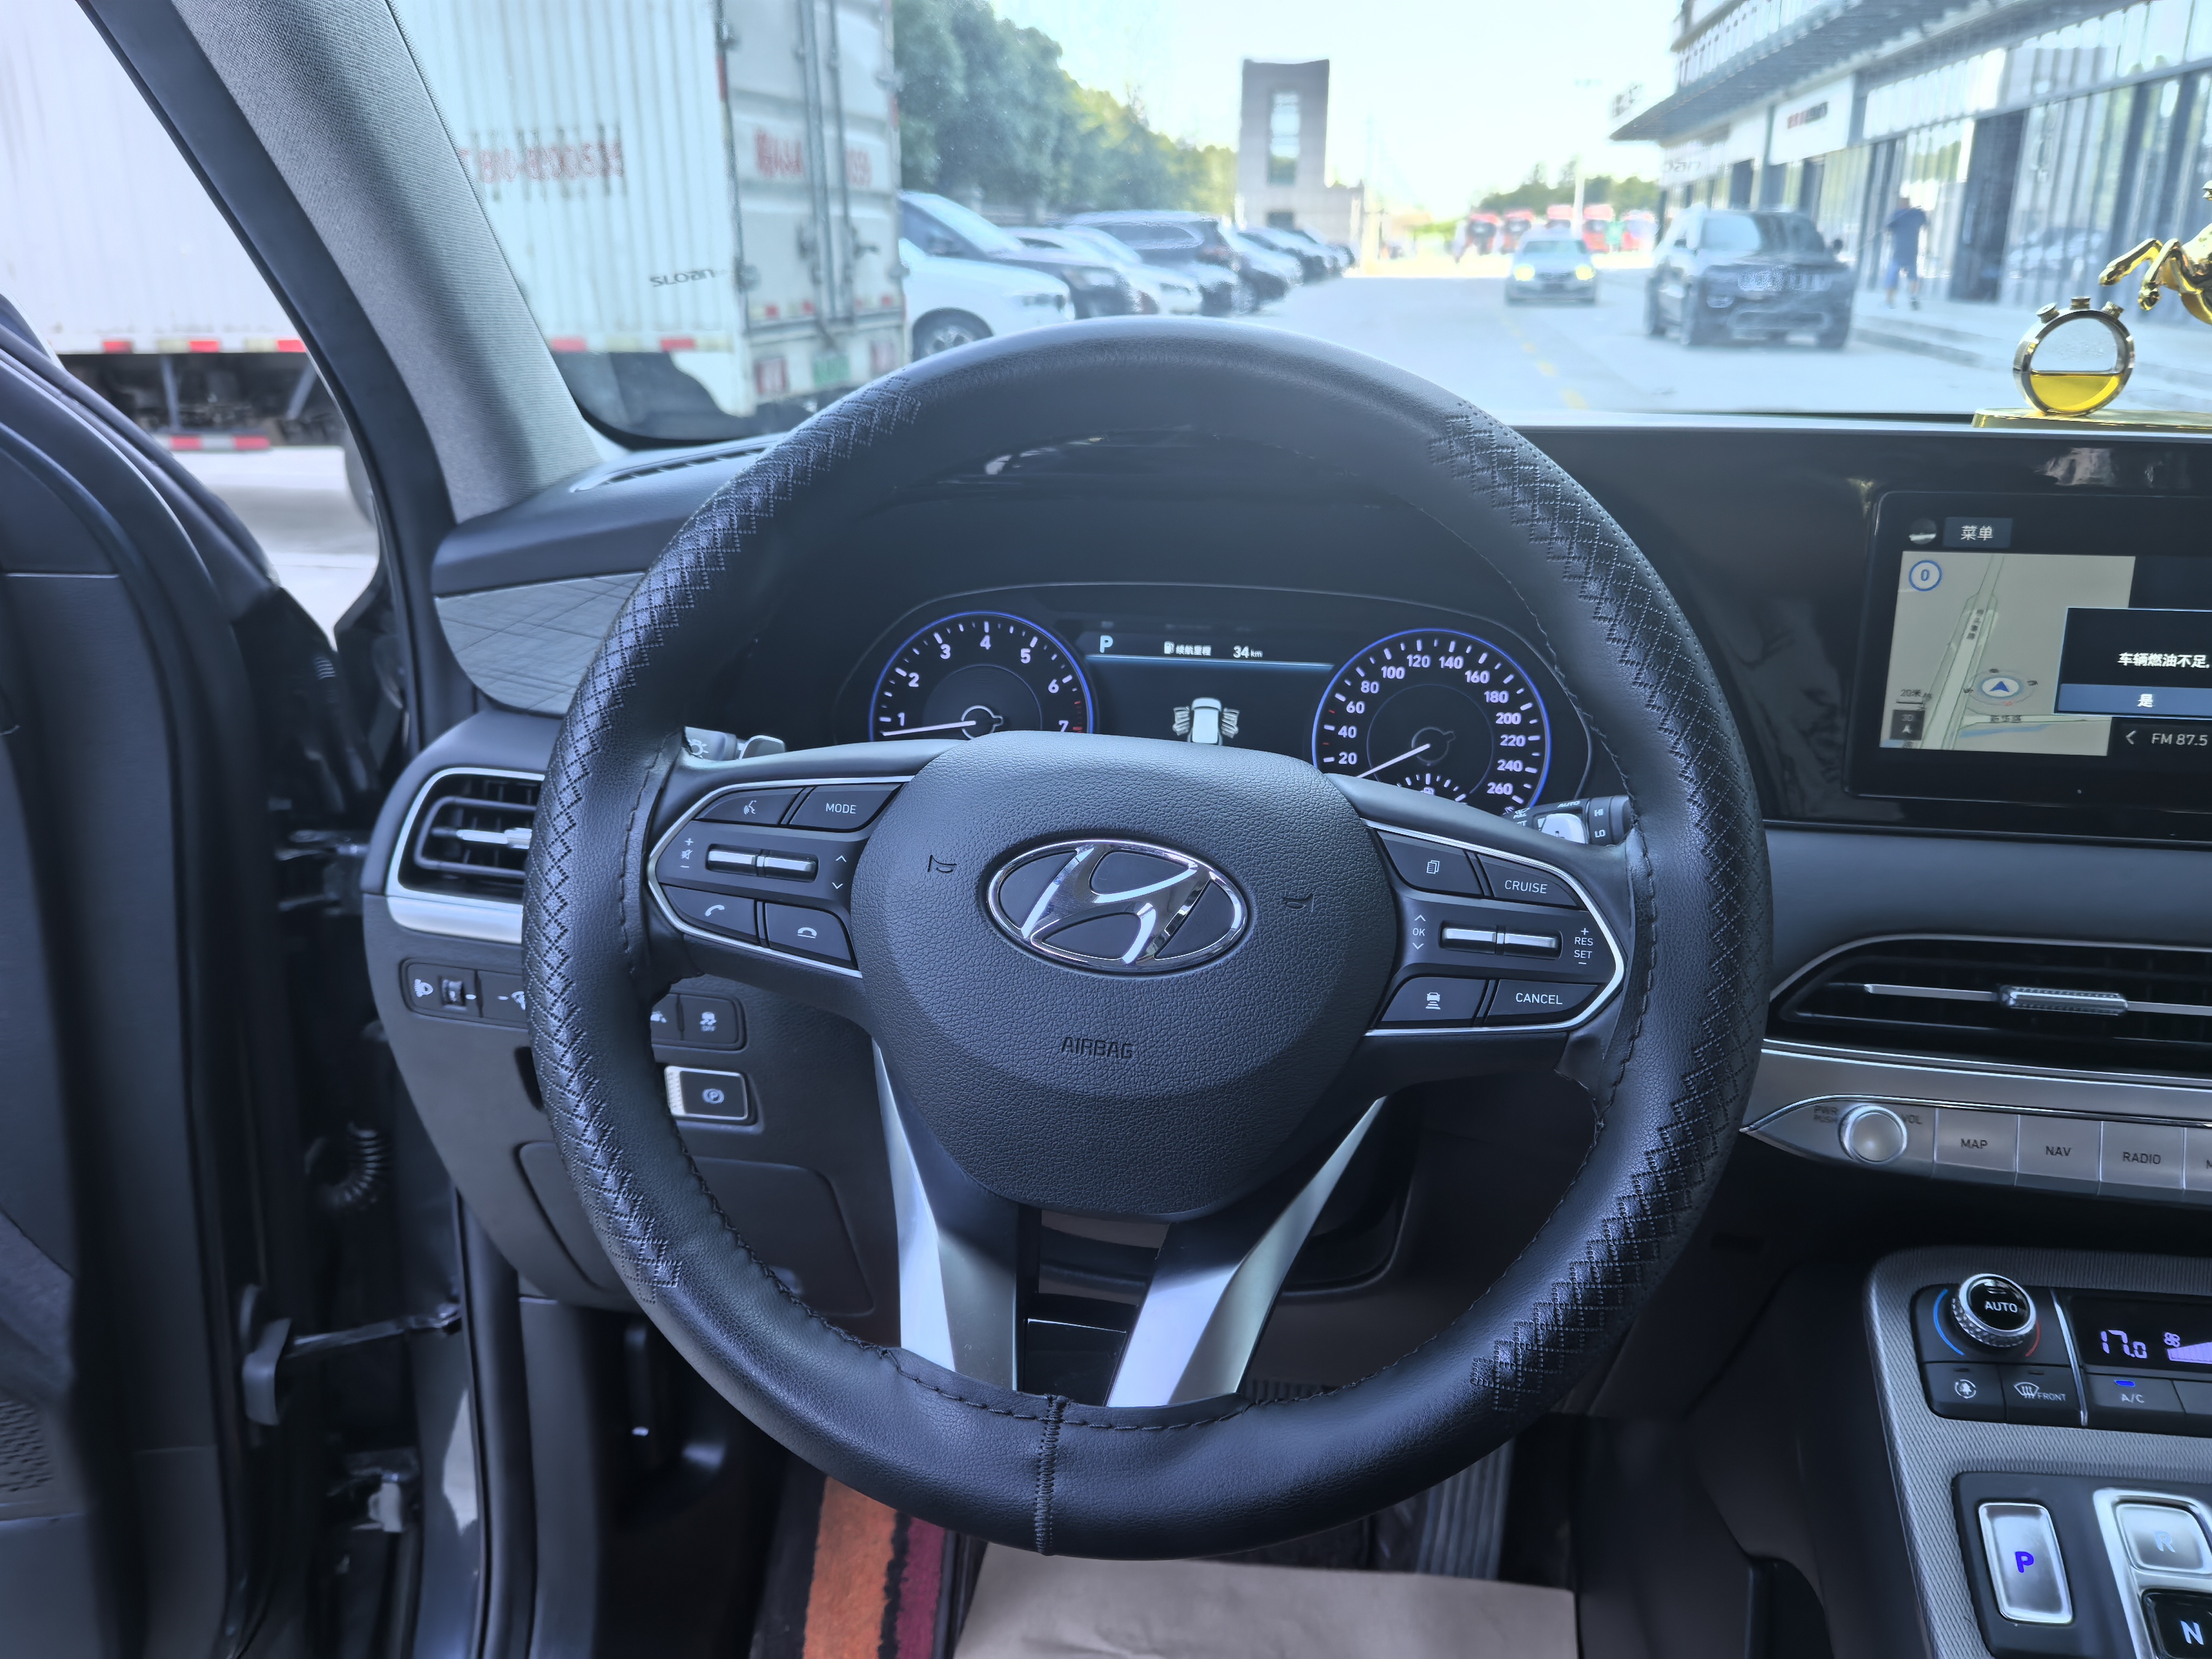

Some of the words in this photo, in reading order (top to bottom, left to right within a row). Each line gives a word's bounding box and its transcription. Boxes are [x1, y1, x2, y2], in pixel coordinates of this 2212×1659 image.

[1960, 525, 1993, 541] 菜单
[1920, 569, 1930, 582] 0
[980, 635, 992, 650] 4
[1100, 635, 1114, 653] P
[939, 643, 951, 659] 3
[1020, 648, 1031, 664] 5
[1233, 645, 1249, 658] 34
[1406, 654, 1431, 669] 120
[1439, 656, 1464, 670] 140
[1381, 665, 1406, 679] 100
[1465, 670, 1490, 684] 160
[908, 672, 920, 687] 2
[1048, 679, 1060, 693] 6
[1360, 680, 1380, 694] 80
[1483, 690, 1509, 704] 180
[2137, 693, 2154, 707] 是
[1346, 700, 1365, 714] 60
[898, 712, 905, 726] 1
[1495, 711, 1521, 725] 200
[1058, 720, 1069, 732] 7
[1338, 725, 1357, 739] 40
[1500, 734, 1526, 747] 220
[2151, 733, 2173, 745] FM
[2176, 733, 2208, 746] 87.5
[1338, 751, 1357, 765] 20
[1496, 759, 1523, 773] 240
[1487, 782, 1513, 795] 260
[825, 802, 858, 814] MODE
[1594, 808, 1604, 817] HI
[1594, 829, 1606, 838] LO
[1504, 879, 1548, 894] CRUISE
[1412, 927, 1426, 937] OK
[1574, 936, 1594, 947] RES
[1573, 949, 1593, 960] SET
[1515, 992, 1563, 1006] CANCEL
[1061, 1036, 1134, 1060] AIRBAG
[1960, 1138, 1988, 1150] MAP
[2045, 1145, 2072, 1157] NAV
[2122, 1151, 2162, 1165] RADIO
[1985, 1300, 2019, 1313] AUTO
[2100, 1330, 2148, 1359] 17.0
[2038, 1392, 2066, 1401] FRONT
[2121, 1393, 2145, 1404] A/C
[2154, 1531, 2176, 1553] R
[2015, 1551, 2034, 1574] P
[2181, 1620, 2204, 1645] N
